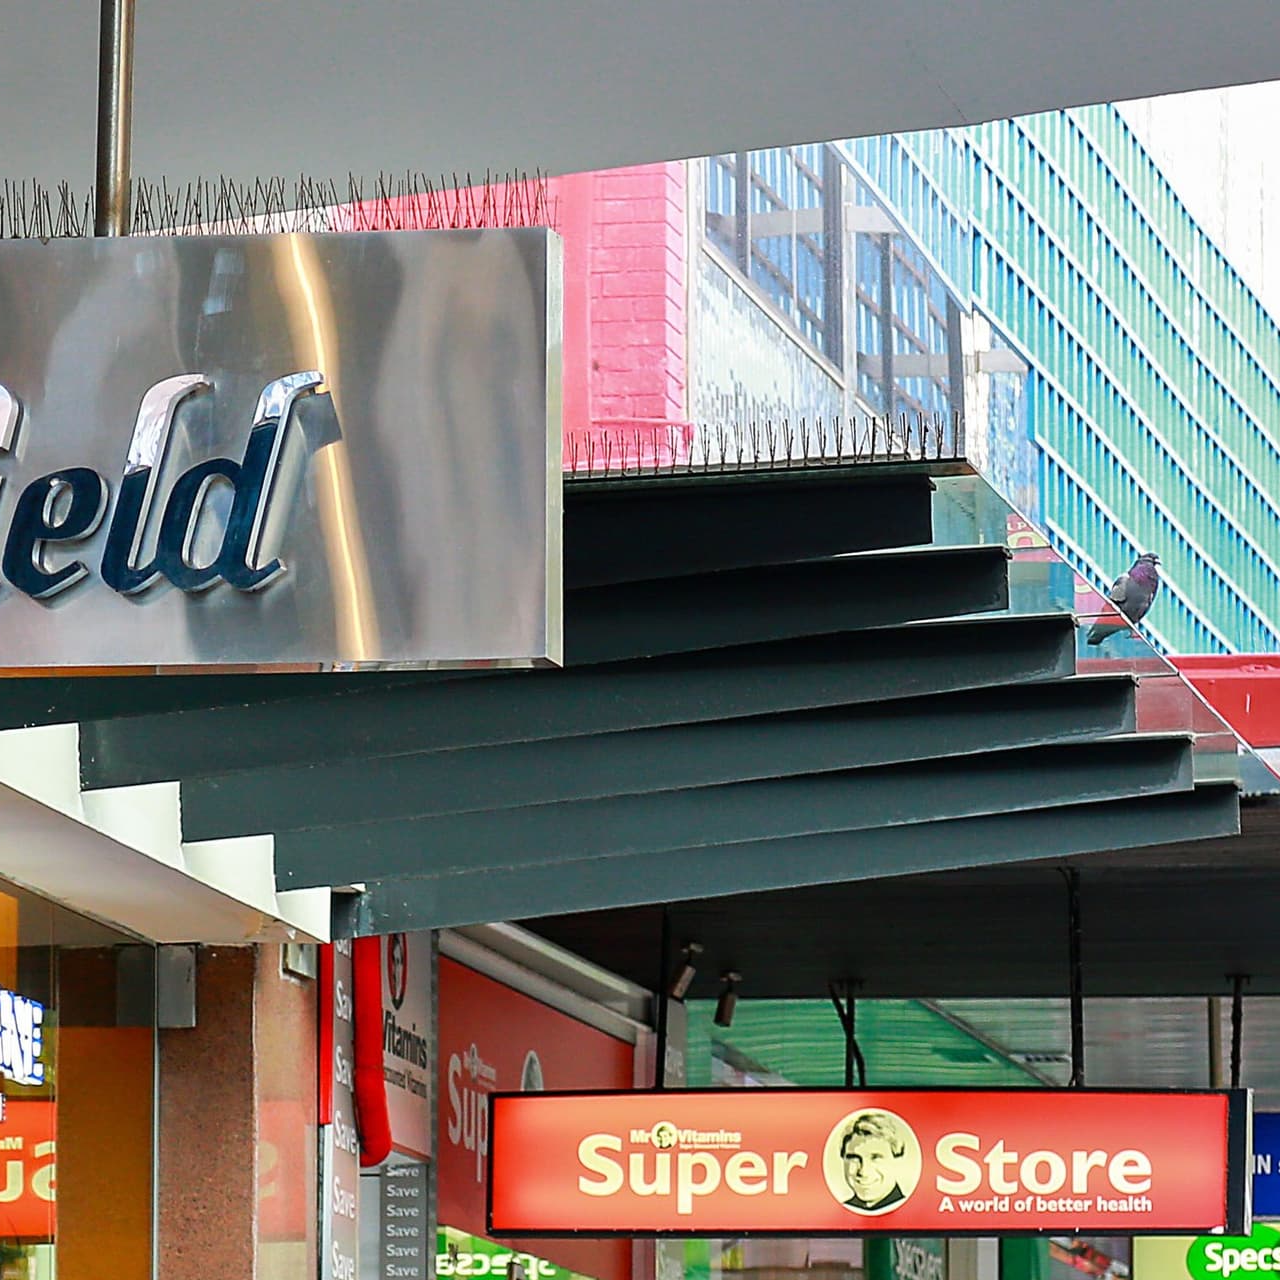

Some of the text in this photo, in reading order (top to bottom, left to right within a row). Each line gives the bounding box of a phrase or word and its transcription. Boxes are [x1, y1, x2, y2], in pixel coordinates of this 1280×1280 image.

[447, 1052, 488, 1183] Sup
[630, 1129, 741, 1143] Mr Vitamins
[577, 1132, 1152, 1214] Super Store
[333, 1175, 356, 1219] Save
[386, 1184, 420, 1197] Save
[386, 1203, 420, 1217] Save
[938, 1196, 1152, 1212] A world of better health
[386, 1223, 420, 1237] Save
[385, 1243, 419, 1257] Save
[385, 1263, 419, 1277] Save
